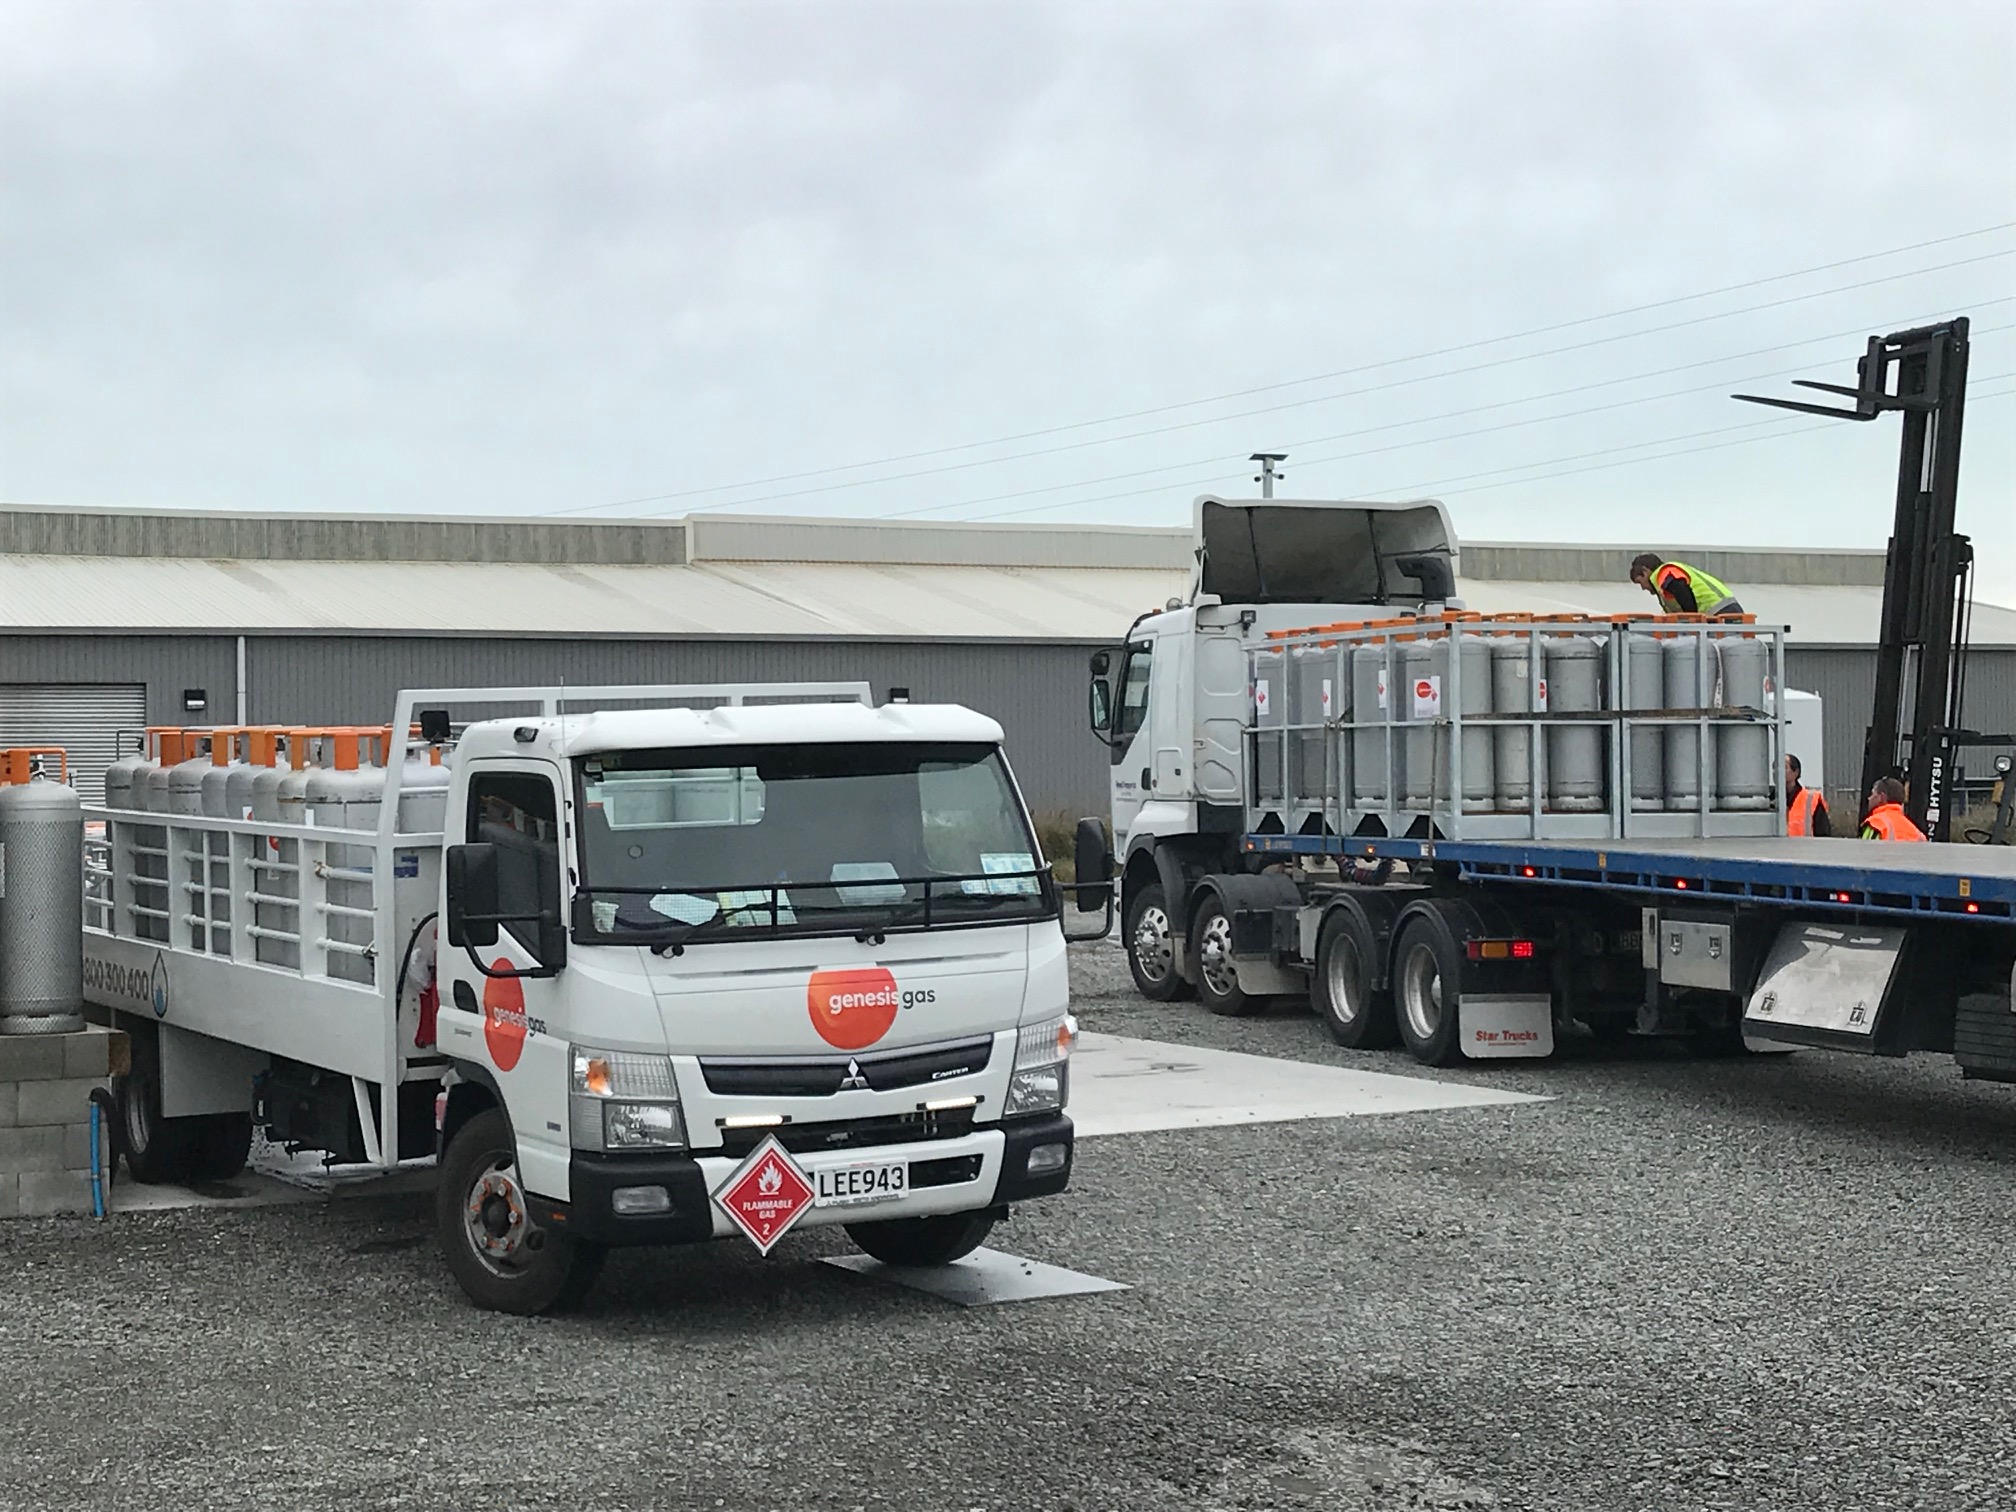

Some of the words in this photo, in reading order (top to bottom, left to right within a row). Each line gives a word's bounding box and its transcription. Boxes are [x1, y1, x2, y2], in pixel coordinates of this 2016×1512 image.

[1929, 757, 1943, 807] HYTSU
[105, 961, 126, 995] 300
[127, 968, 149, 1000] 400
[829, 985, 899, 1015] genesis
[902, 989, 936, 1010] gas
[493, 1005, 528, 1028] genesis
[528, 1017, 547, 1037] gas
[1475, 1030, 1499, 1041] Star
[1502, 1030, 1538, 1041] Trucks
[820, 1166, 904, 1198] LEE943
[743, 1199, 793, 1211] FLAMMABLE
[758, 1210, 776, 1219] GAS
[762, 1223, 770, 1235] 2
